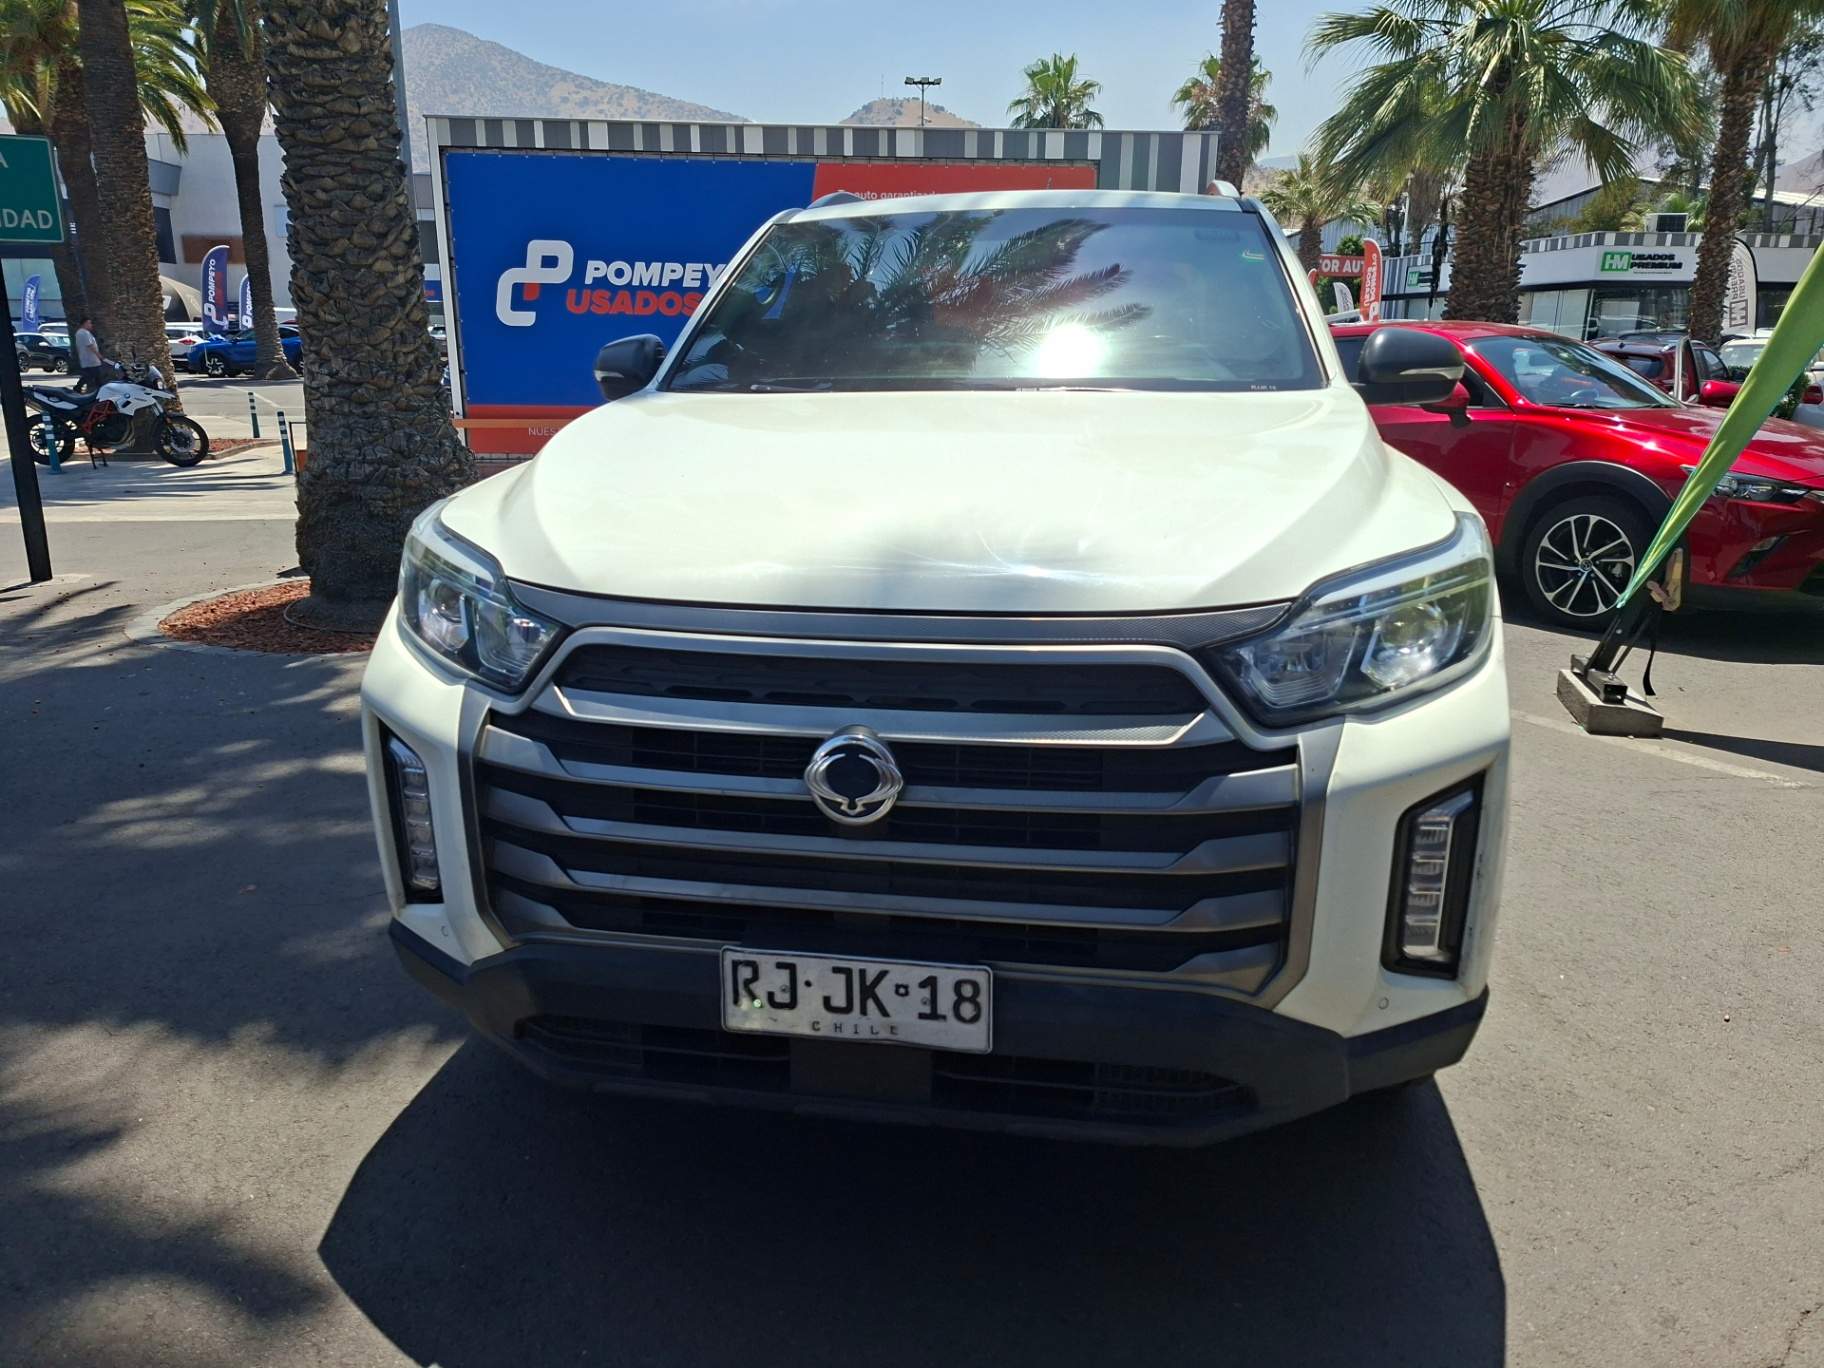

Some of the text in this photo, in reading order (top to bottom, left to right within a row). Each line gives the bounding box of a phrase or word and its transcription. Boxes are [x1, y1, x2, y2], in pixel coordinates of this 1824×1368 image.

[0, 208, 53, 229] DAD
[584, 260, 728, 288] POMPEY
[1319, 258, 1340, 273] OR
[208, 258, 217, 303] POMPEYO
[566, 288, 704, 318] USADOS
[528, 427, 560, 436] NUES
[811, 1020, 900, 1036] CHILE
